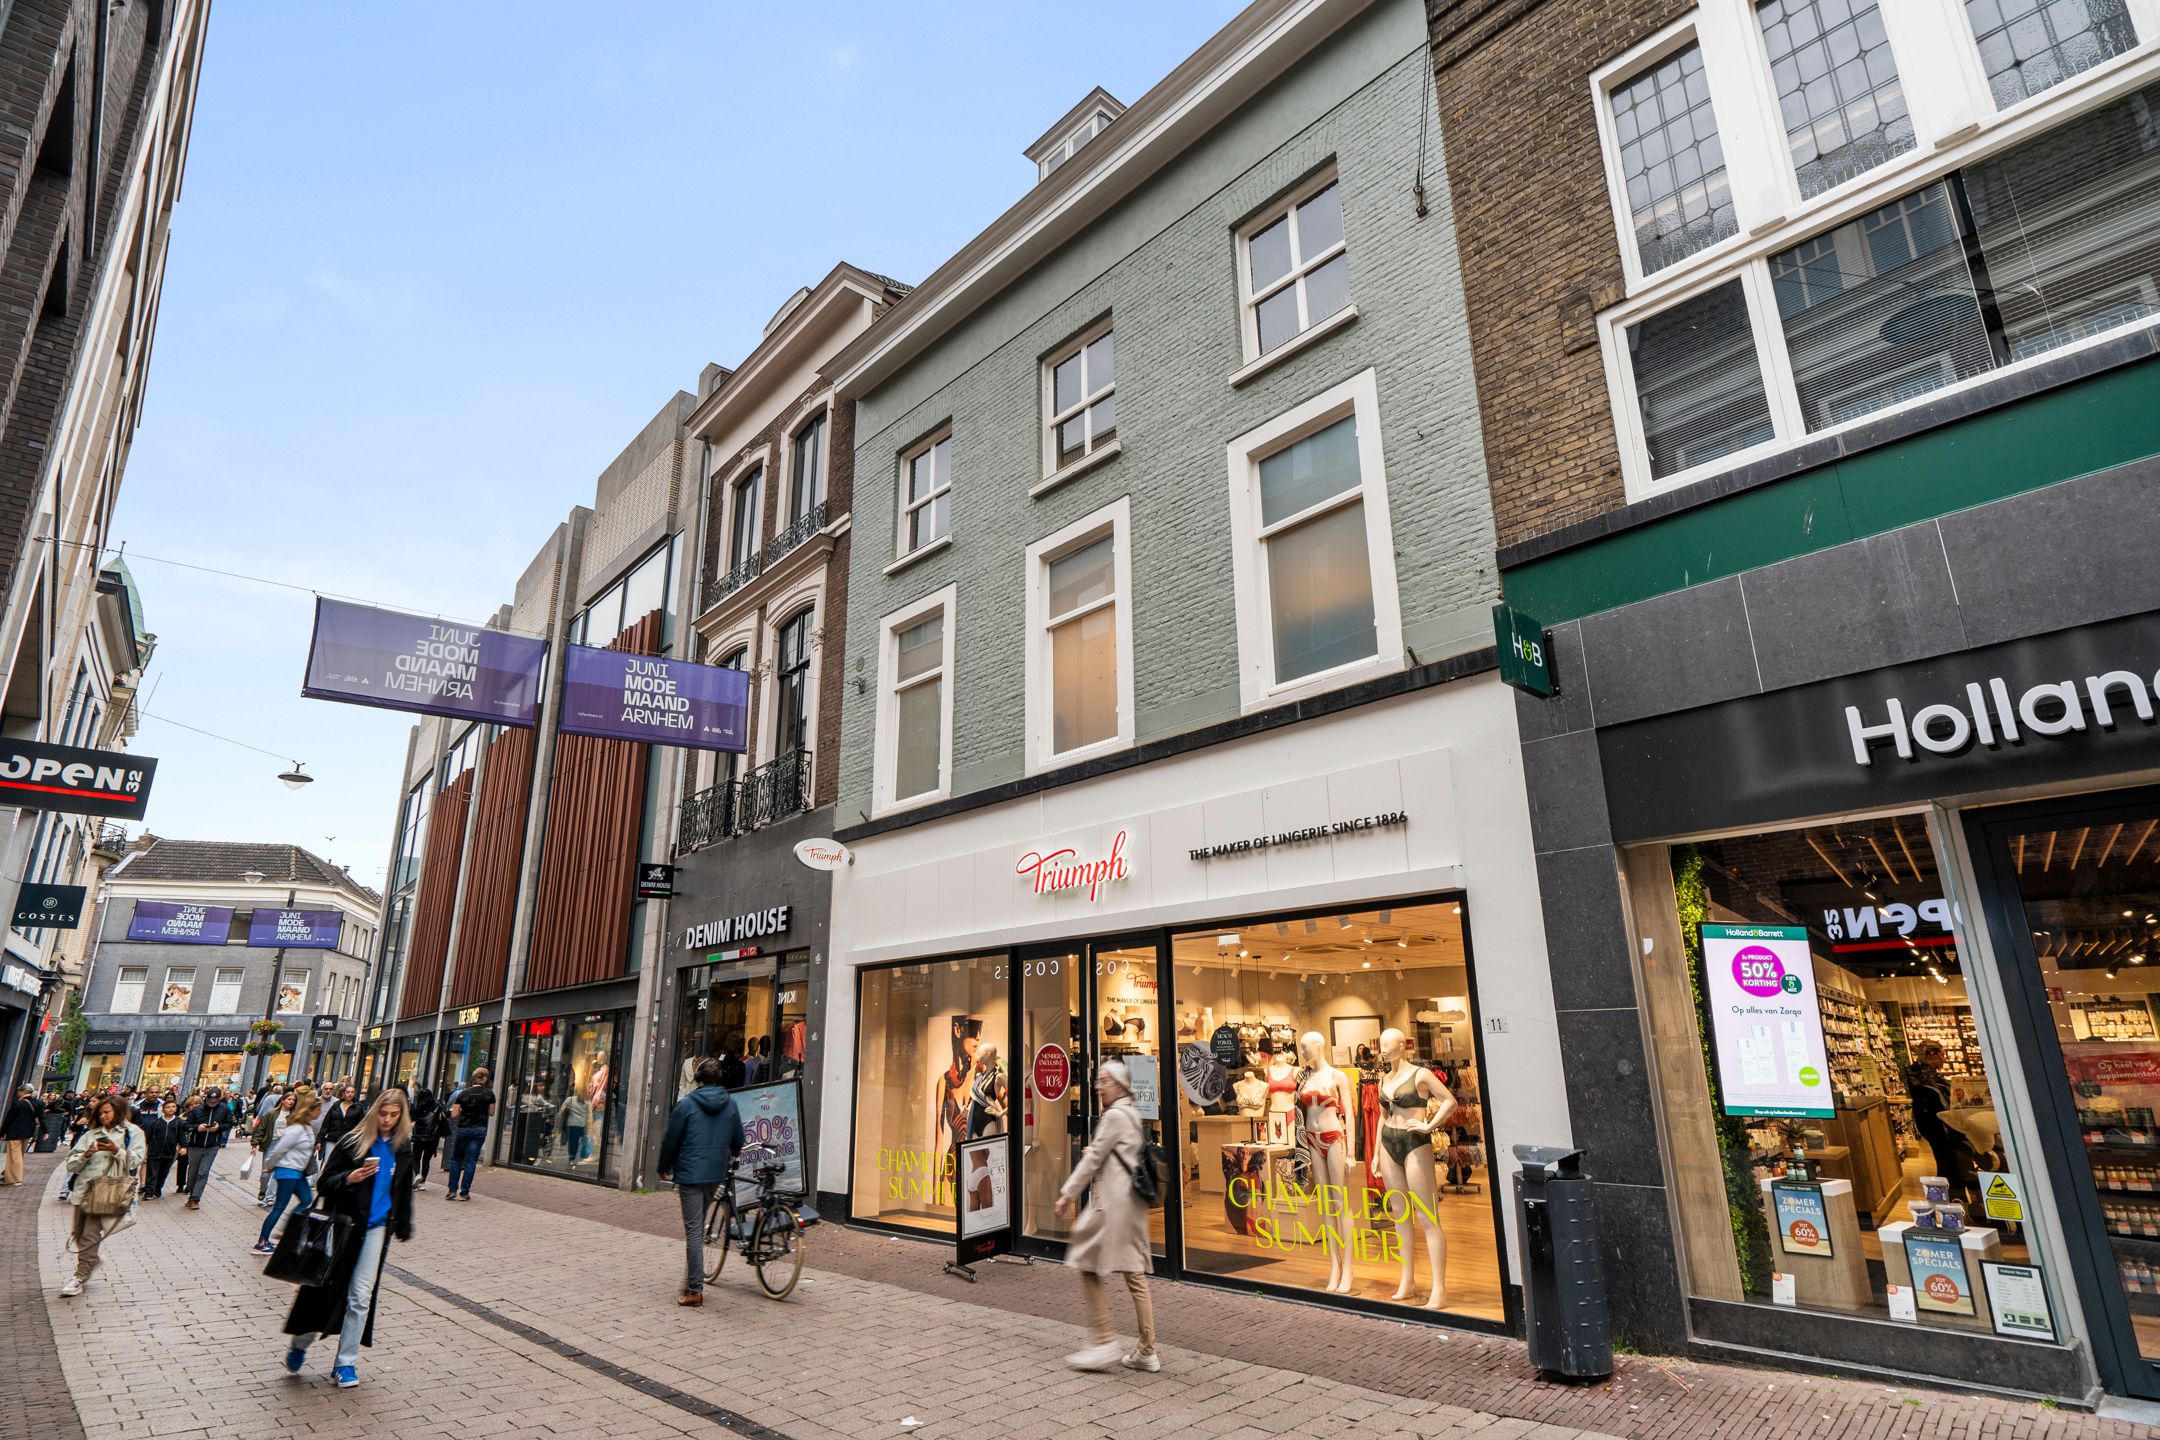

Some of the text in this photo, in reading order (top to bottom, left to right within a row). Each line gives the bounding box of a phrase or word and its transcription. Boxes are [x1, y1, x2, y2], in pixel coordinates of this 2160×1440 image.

[625, 659, 669, 679] JUNI
[625, 674, 677, 695] MODE
[623, 690, 690, 712] MAAND
[621, 707, 694, 730] ARNHEM
[125, 770, 143, 793] 32
[1189, 811, 1408, 860] THE MAKER OF LINGERIE SINCE 1886
[803, 844, 843, 865] Triumph
[1016, 830, 1128, 902] Triumph
[641, 881, 656, 889] DENIM
[18, 912, 75, 922] COSTES
[278, 911, 301, 919] JUNI
[278, 918, 305, 926] MODE
[685, 905, 788, 950] DENIM HOUSE
[277, 925, 310, 933] MAAND
[275, 933, 312, 941] ARNHEM
[1741, 962, 1777, 978] 50%
[1126, 972, 1158, 994] Triump
[1743, 979, 1779, 988] KORTING
[1732, 1006, 1744, 1016] Op
[1746, 1006, 1763, 1014] alles
[1491, 1018, 1502, 1031] 11
[208, 1036, 240, 1047] SIEBEL
[743, 1115, 793, 1145] 50%
[1228, 1177, 1438, 1227] CHAMELEON
[1779, 1204, 1822, 1216] SPECIALS
[1794, 1228, 1816, 1238] 60%
[1255, 1217, 1408, 1266] SUMMER
[1911, 1256, 1961, 1269] SPECIALS
[1930, 1283, 1954, 1293] 60%
[1930, 1291, 1957, 1299] KORTING
